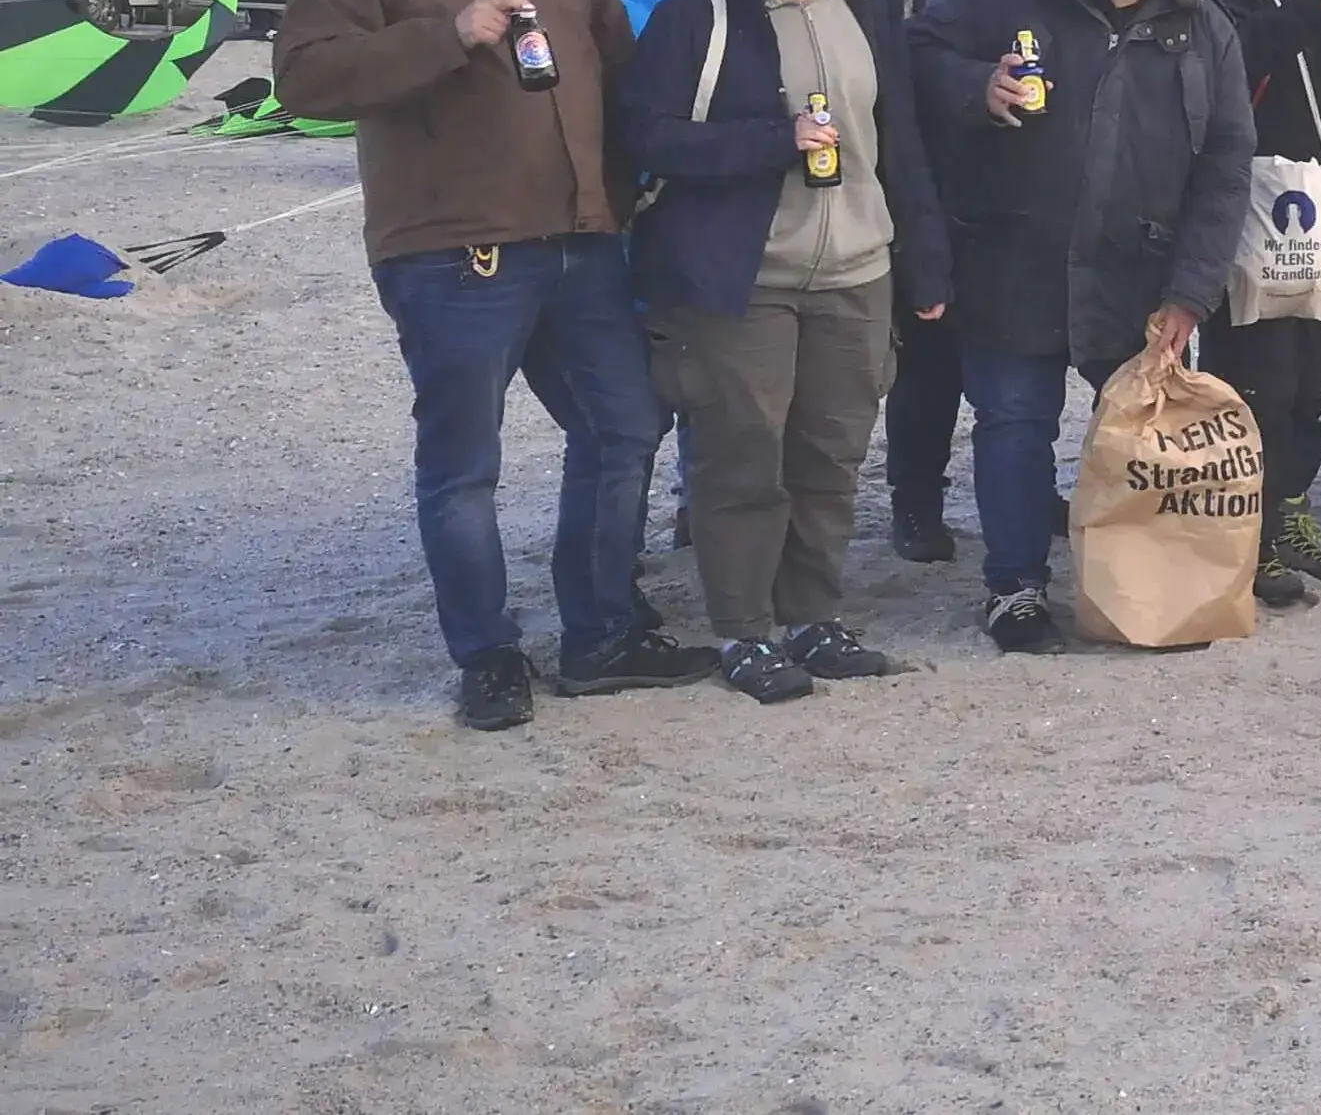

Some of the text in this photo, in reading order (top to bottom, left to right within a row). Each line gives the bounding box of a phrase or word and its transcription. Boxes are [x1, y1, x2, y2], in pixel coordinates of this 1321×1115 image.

[1264, 238, 1283, 251] Wir
[1275, 252, 1314, 265] FLENS
[1126, 445, 1264, 491] StrandG
[1155, 488, 1260, 517] Aktion
